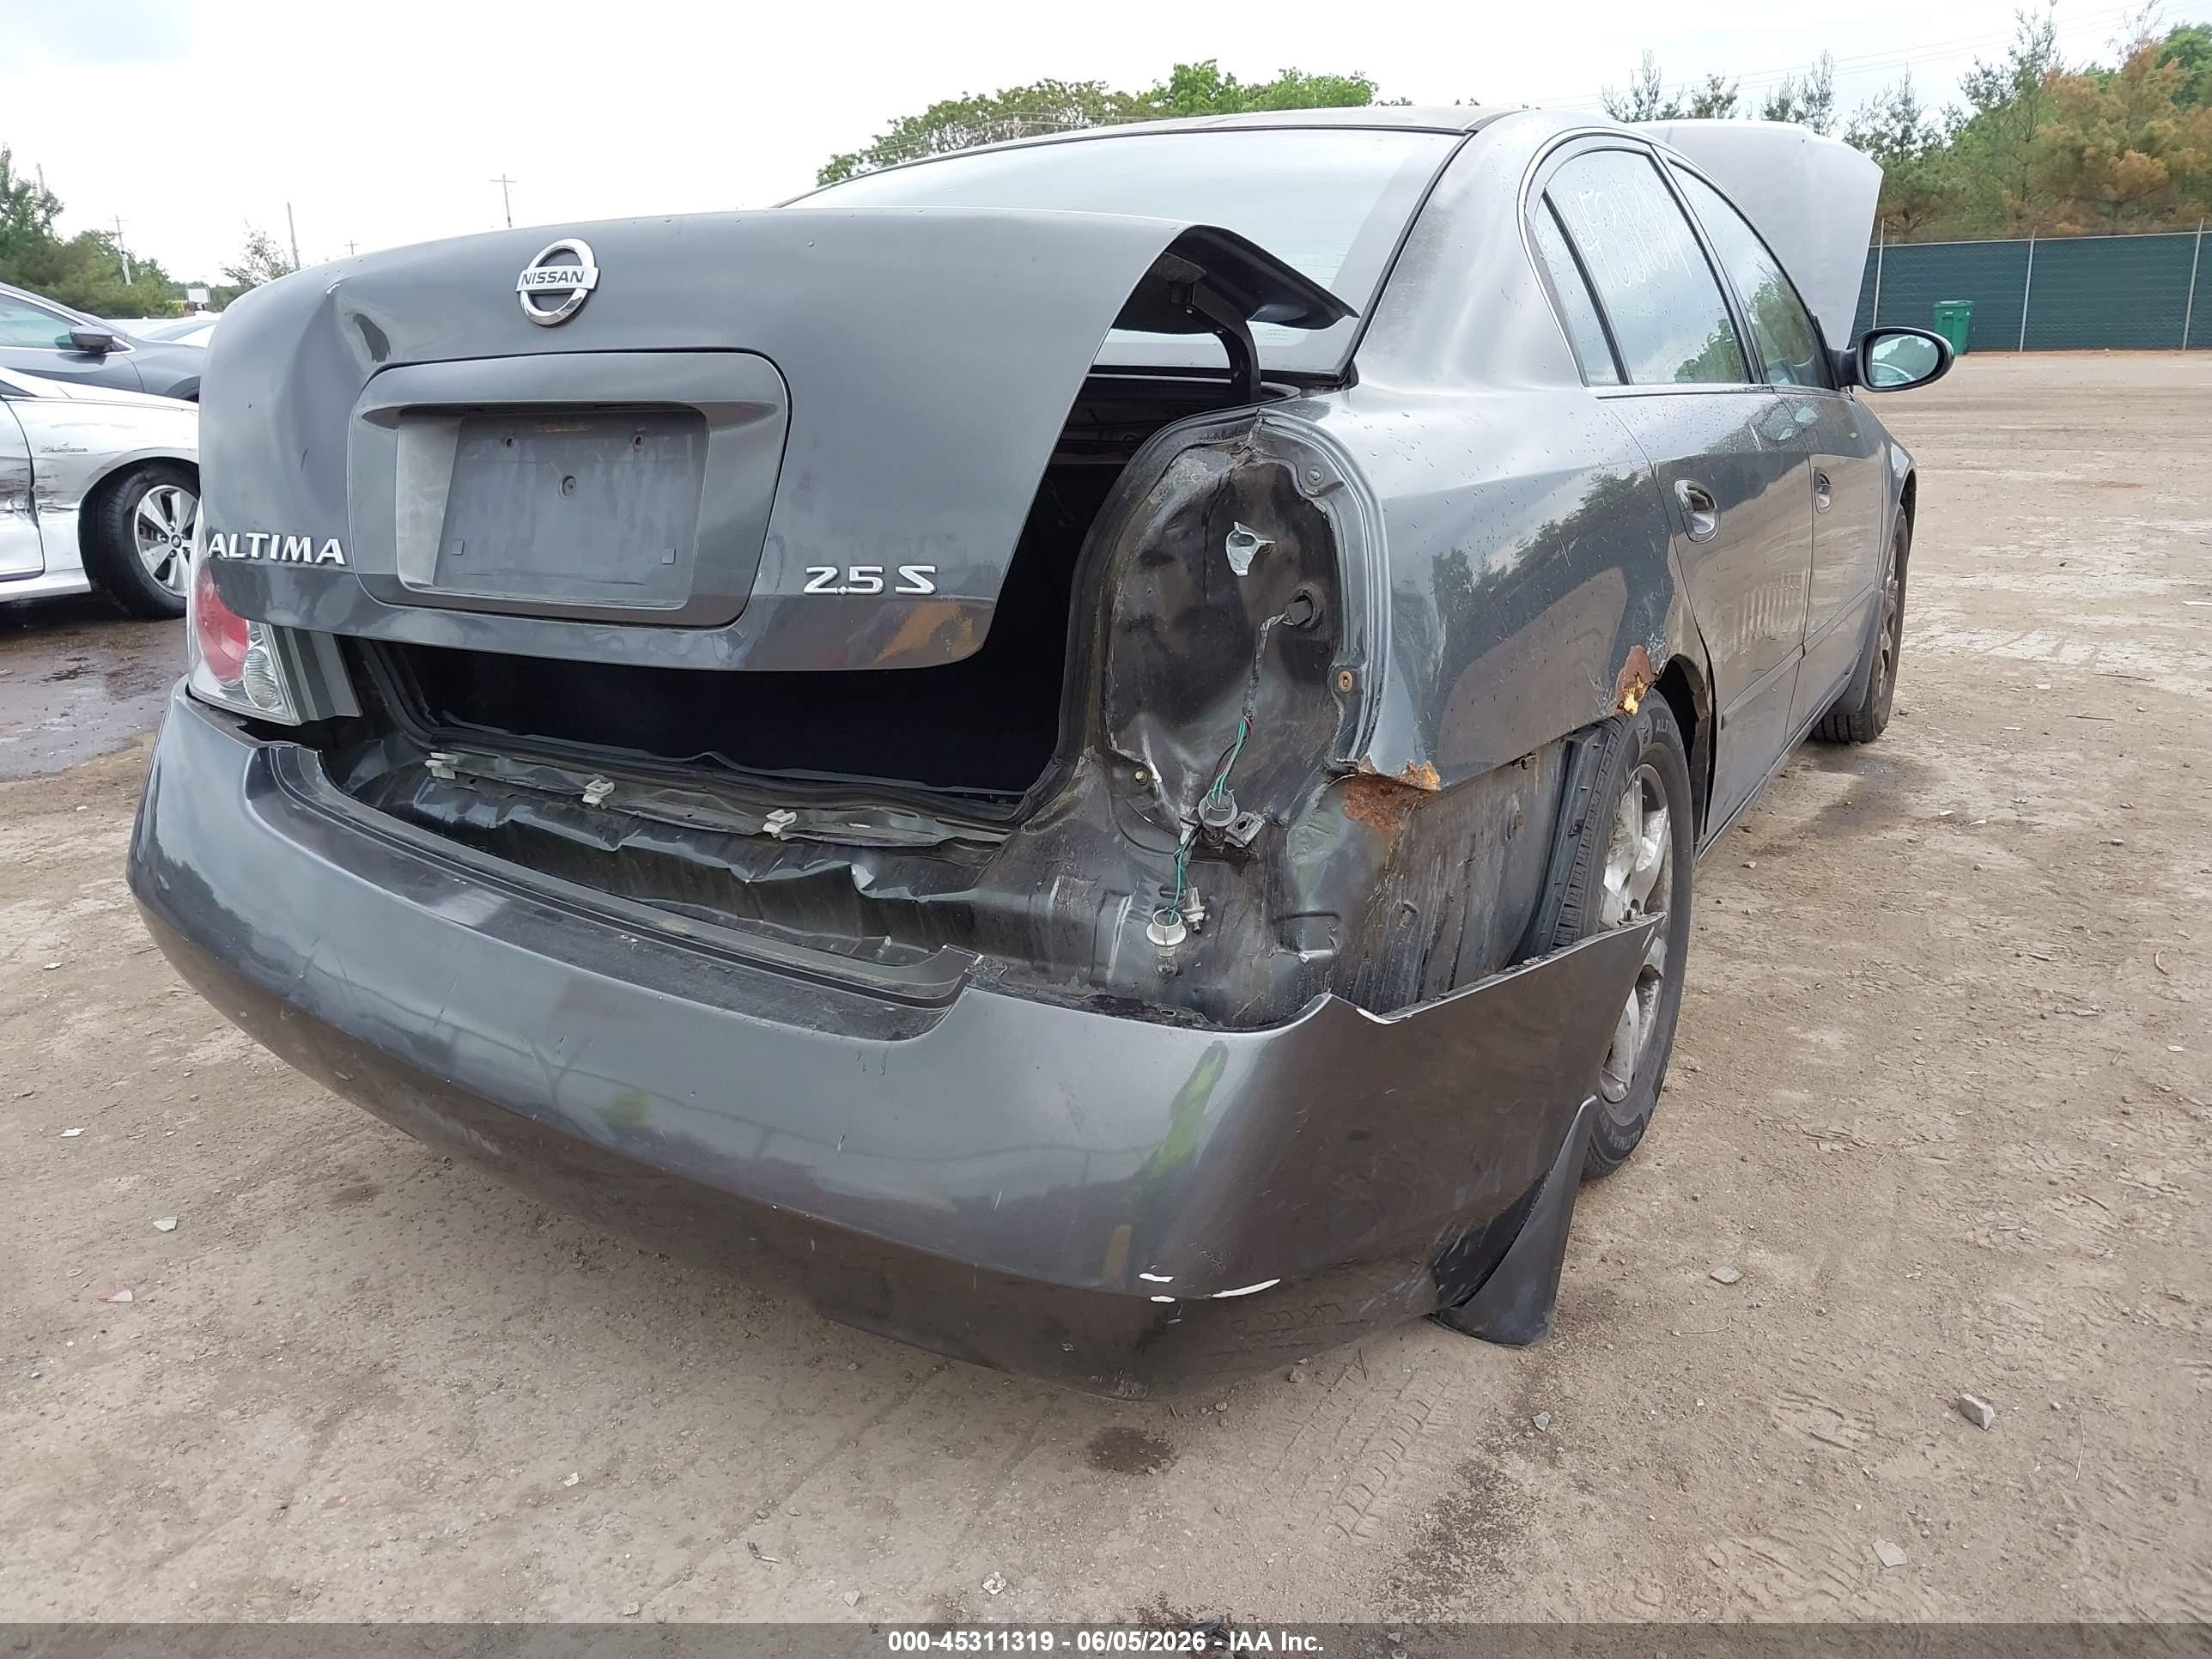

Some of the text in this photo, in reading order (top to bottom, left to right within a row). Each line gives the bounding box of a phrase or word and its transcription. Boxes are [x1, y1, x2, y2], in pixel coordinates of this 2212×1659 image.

[521, 270, 585, 285] NISSAN
[205, 532, 346, 565] ALTIMA
[803, 565, 937, 595] 2.5 S
